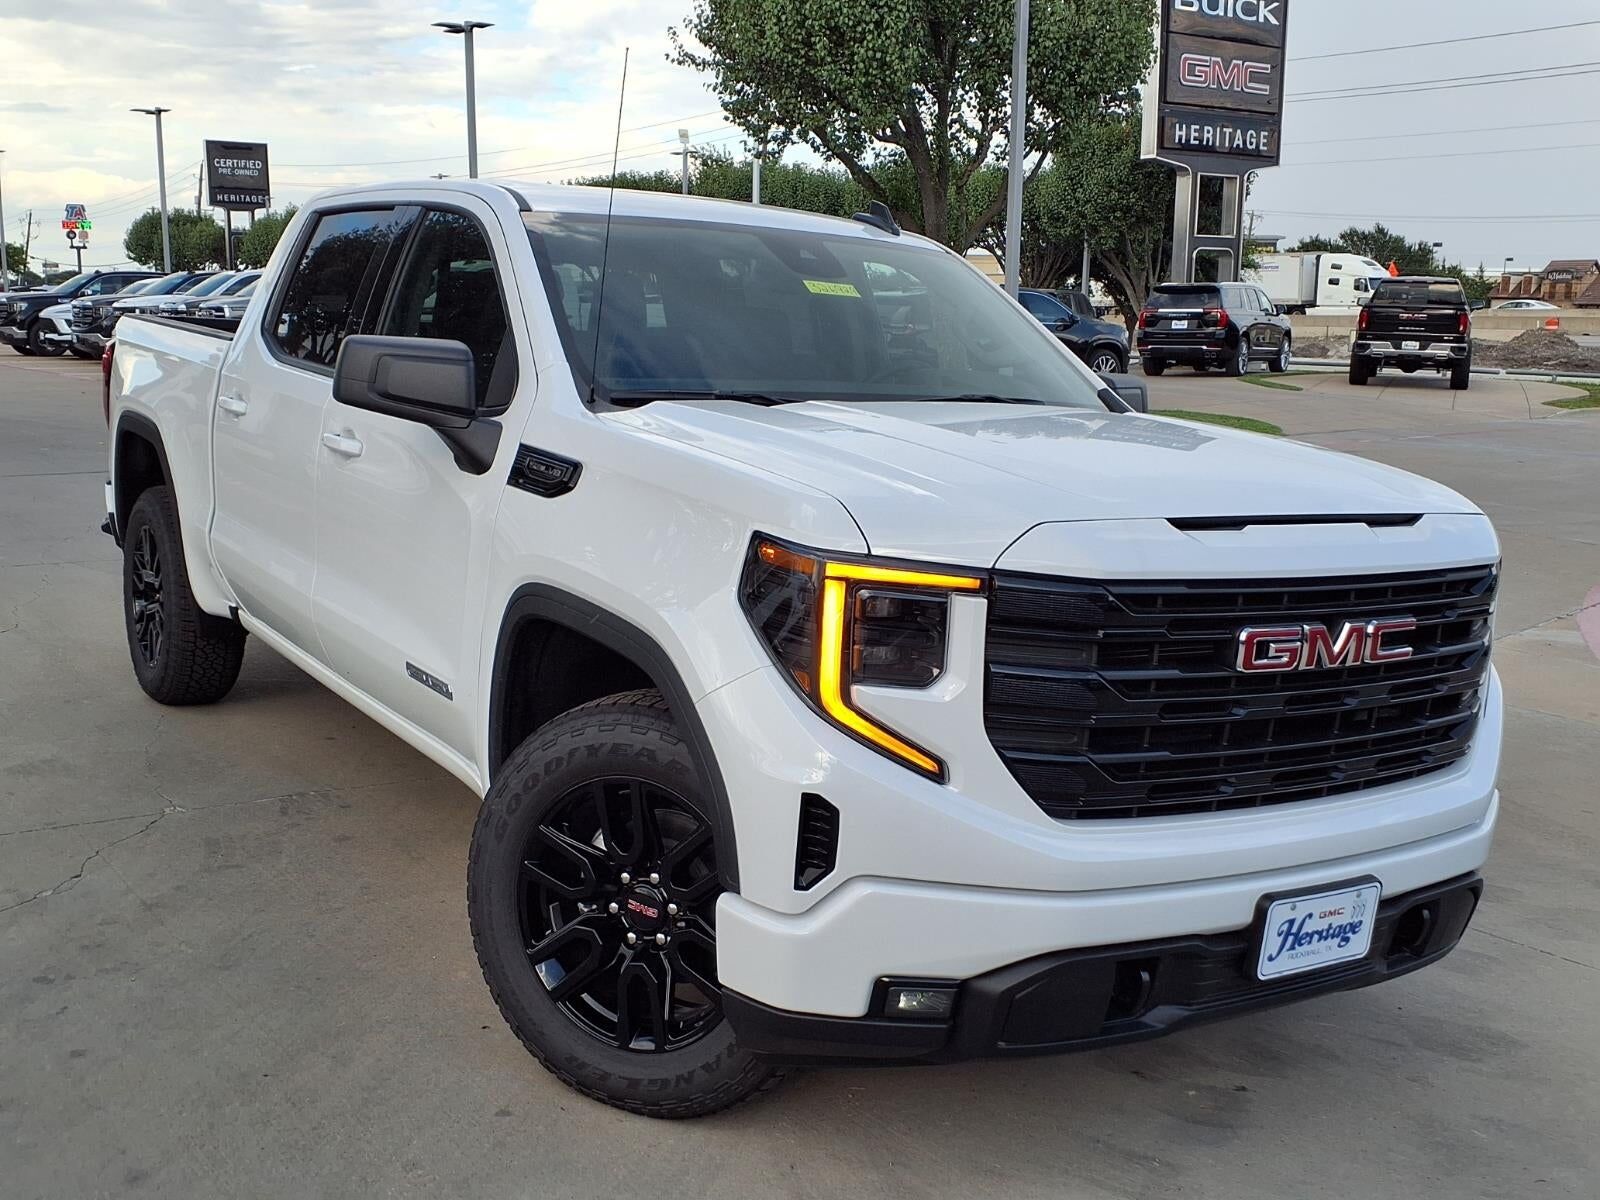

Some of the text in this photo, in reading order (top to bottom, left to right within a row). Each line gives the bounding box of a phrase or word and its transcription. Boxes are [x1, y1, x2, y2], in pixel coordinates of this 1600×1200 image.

[1180, 53, 1271, 95] GMC
[1174, 123, 1269, 150] HERITAGE
[214, 158, 262, 169] CERTIFIED
[218, 168, 259, 176] PRE-OWNED
[217, 194, 266, 203] HERITAGE
[66, 205, 85, 219] TA
[1236, 615, 1417, 673] GMC
[627, 898, 659, 918] GMC
[1318, 906, 1346, 919] GMC
[1267, 911, 1363, 962] Heritage
